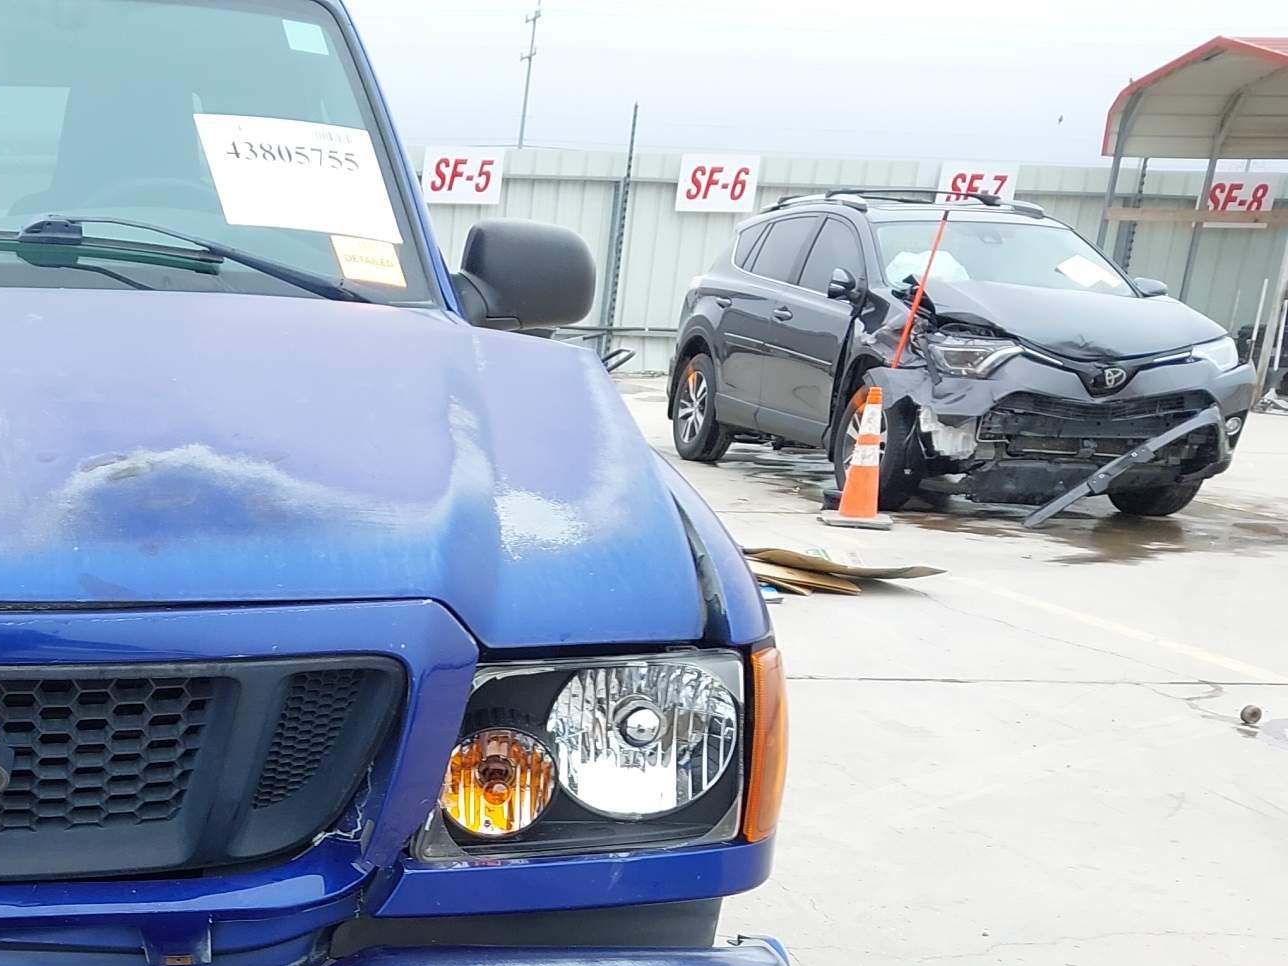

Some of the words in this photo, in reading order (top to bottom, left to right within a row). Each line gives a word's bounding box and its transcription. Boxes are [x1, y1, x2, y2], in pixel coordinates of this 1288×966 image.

[226, 141, 360, 172] 43805755
[430, 158, 495, 192] SF-5
[686, 166, 750, 200] SF-6
[945, 173, 1008, 202] SF-7
[1209, 183, 1269, 211] SF-8
